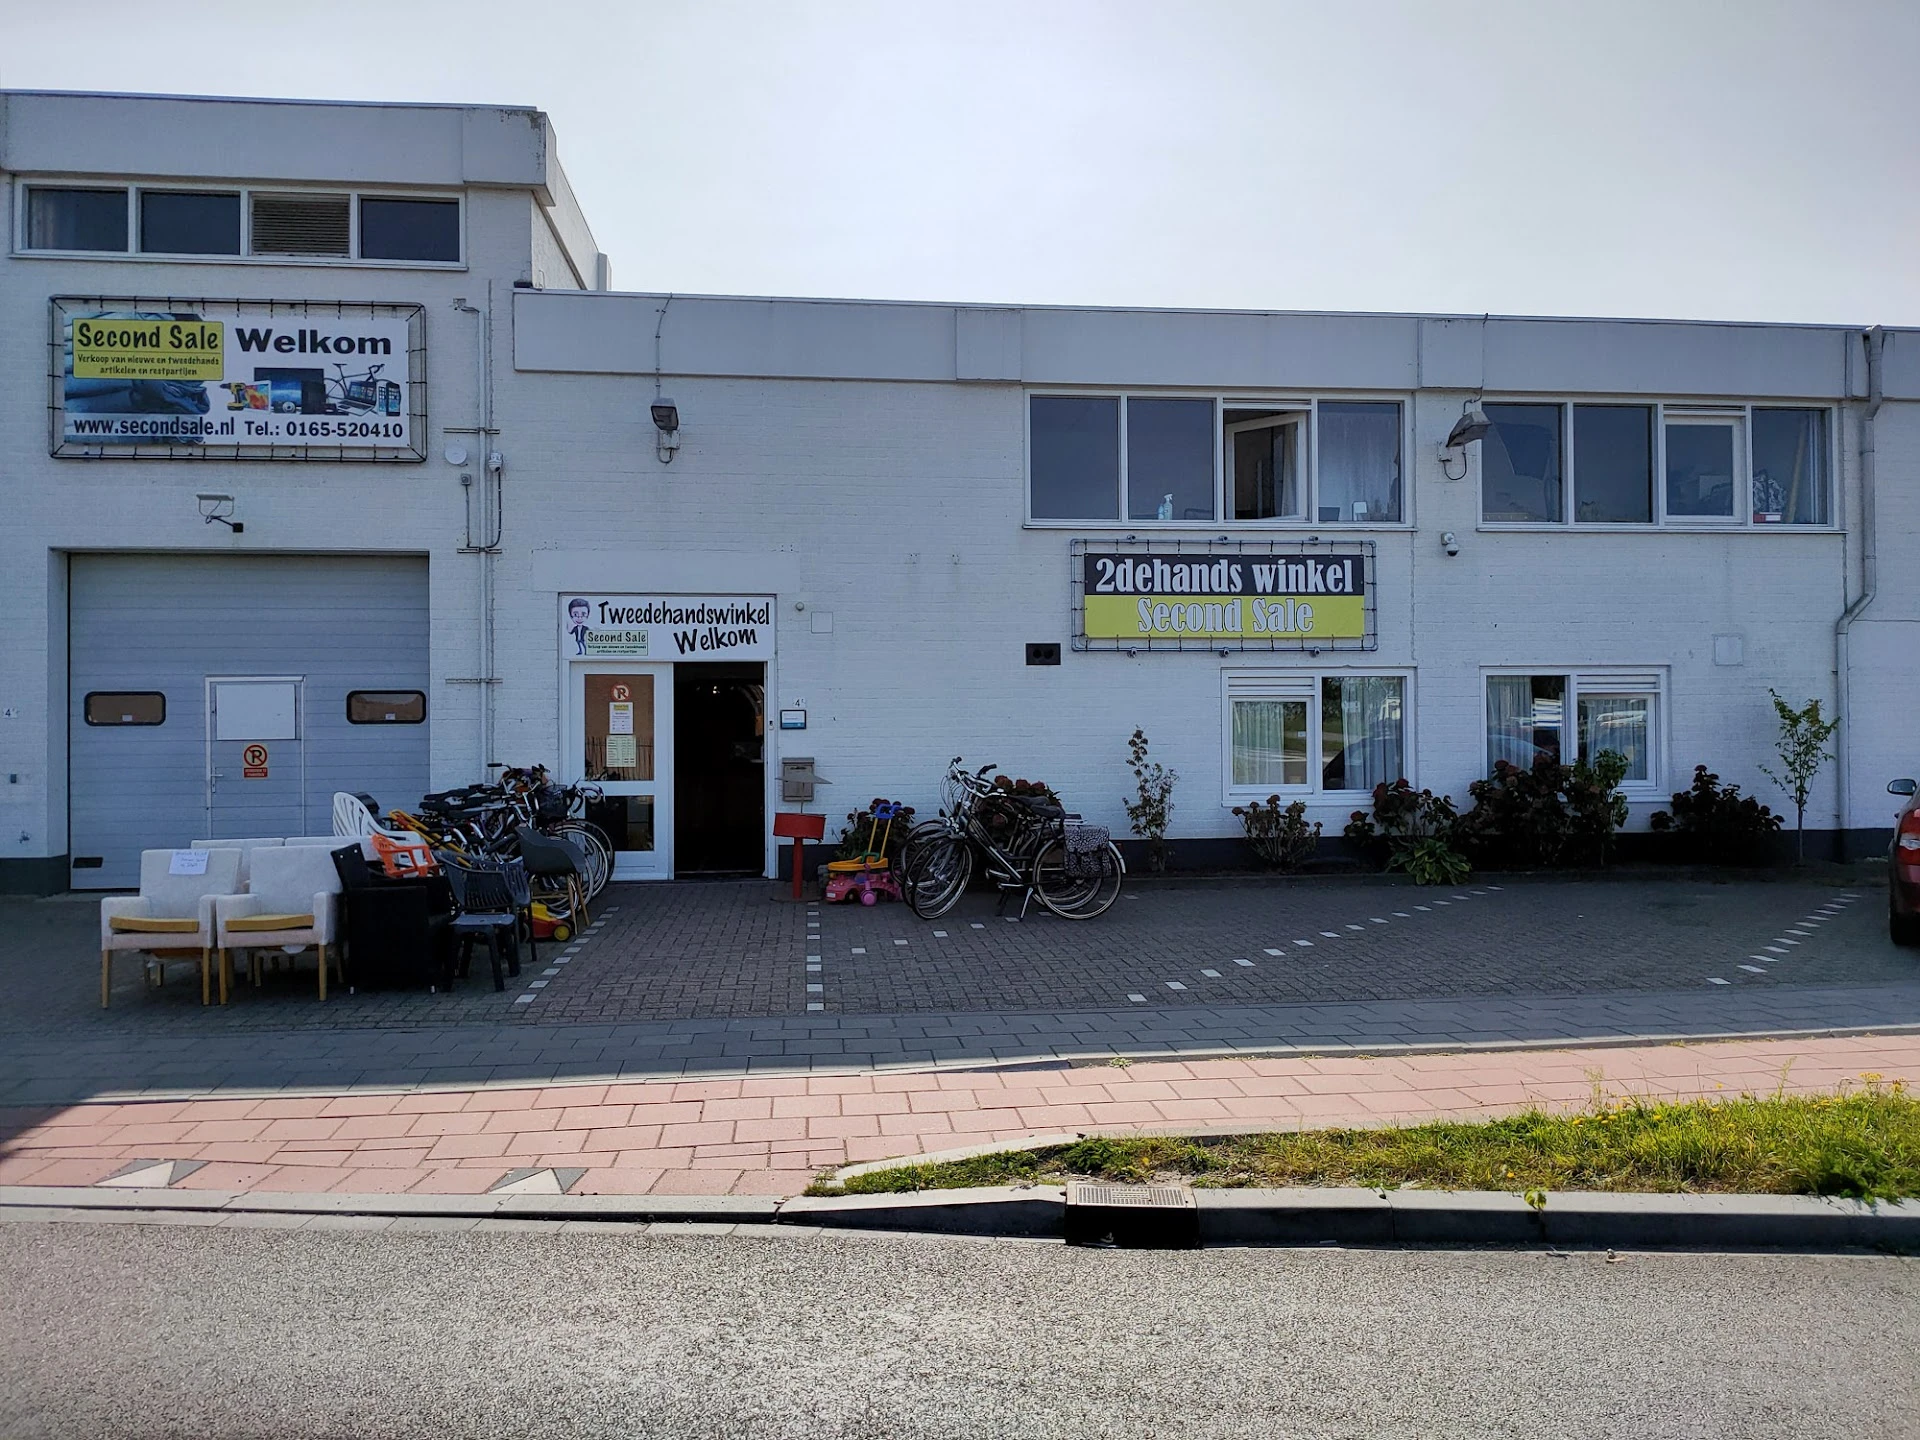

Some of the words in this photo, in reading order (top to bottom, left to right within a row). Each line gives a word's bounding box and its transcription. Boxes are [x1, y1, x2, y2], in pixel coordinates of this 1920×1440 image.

[78, 322, 161, 348] Second
[168, 324, 219, 350] Sale
[235, 327, 391, 355] Welkom
[77, 353, 109, 364] Verkoop
[110, 355, 126, 363] van
[127, 355, 155, 364] nieuwe
[168, 356, 219, 366] tweedehands
[100, 365, 137, 374] artikelen
[138, 367, 148, 375] en
[149, 366, 197, 377] restpartijen
[73, 416, 235, 436] www.secondsale.nl
[244, 420, 280, 436] Tel.:
[286, 421, 403, 438] 0165-520410
[1095, 557, 1243, 593] 2dehands
[1251, 559, 1354, 593] winkel
[598, 600, 770, 626] Tweedehandswinkel
[1137, 597, 1243, 633] Second
[1251, 598, 1314, 633] Sale
[587, 631, 623, 643] Second
[625, 631, 647, 643] Sale
[673, 627, 758, 655] Welkom
